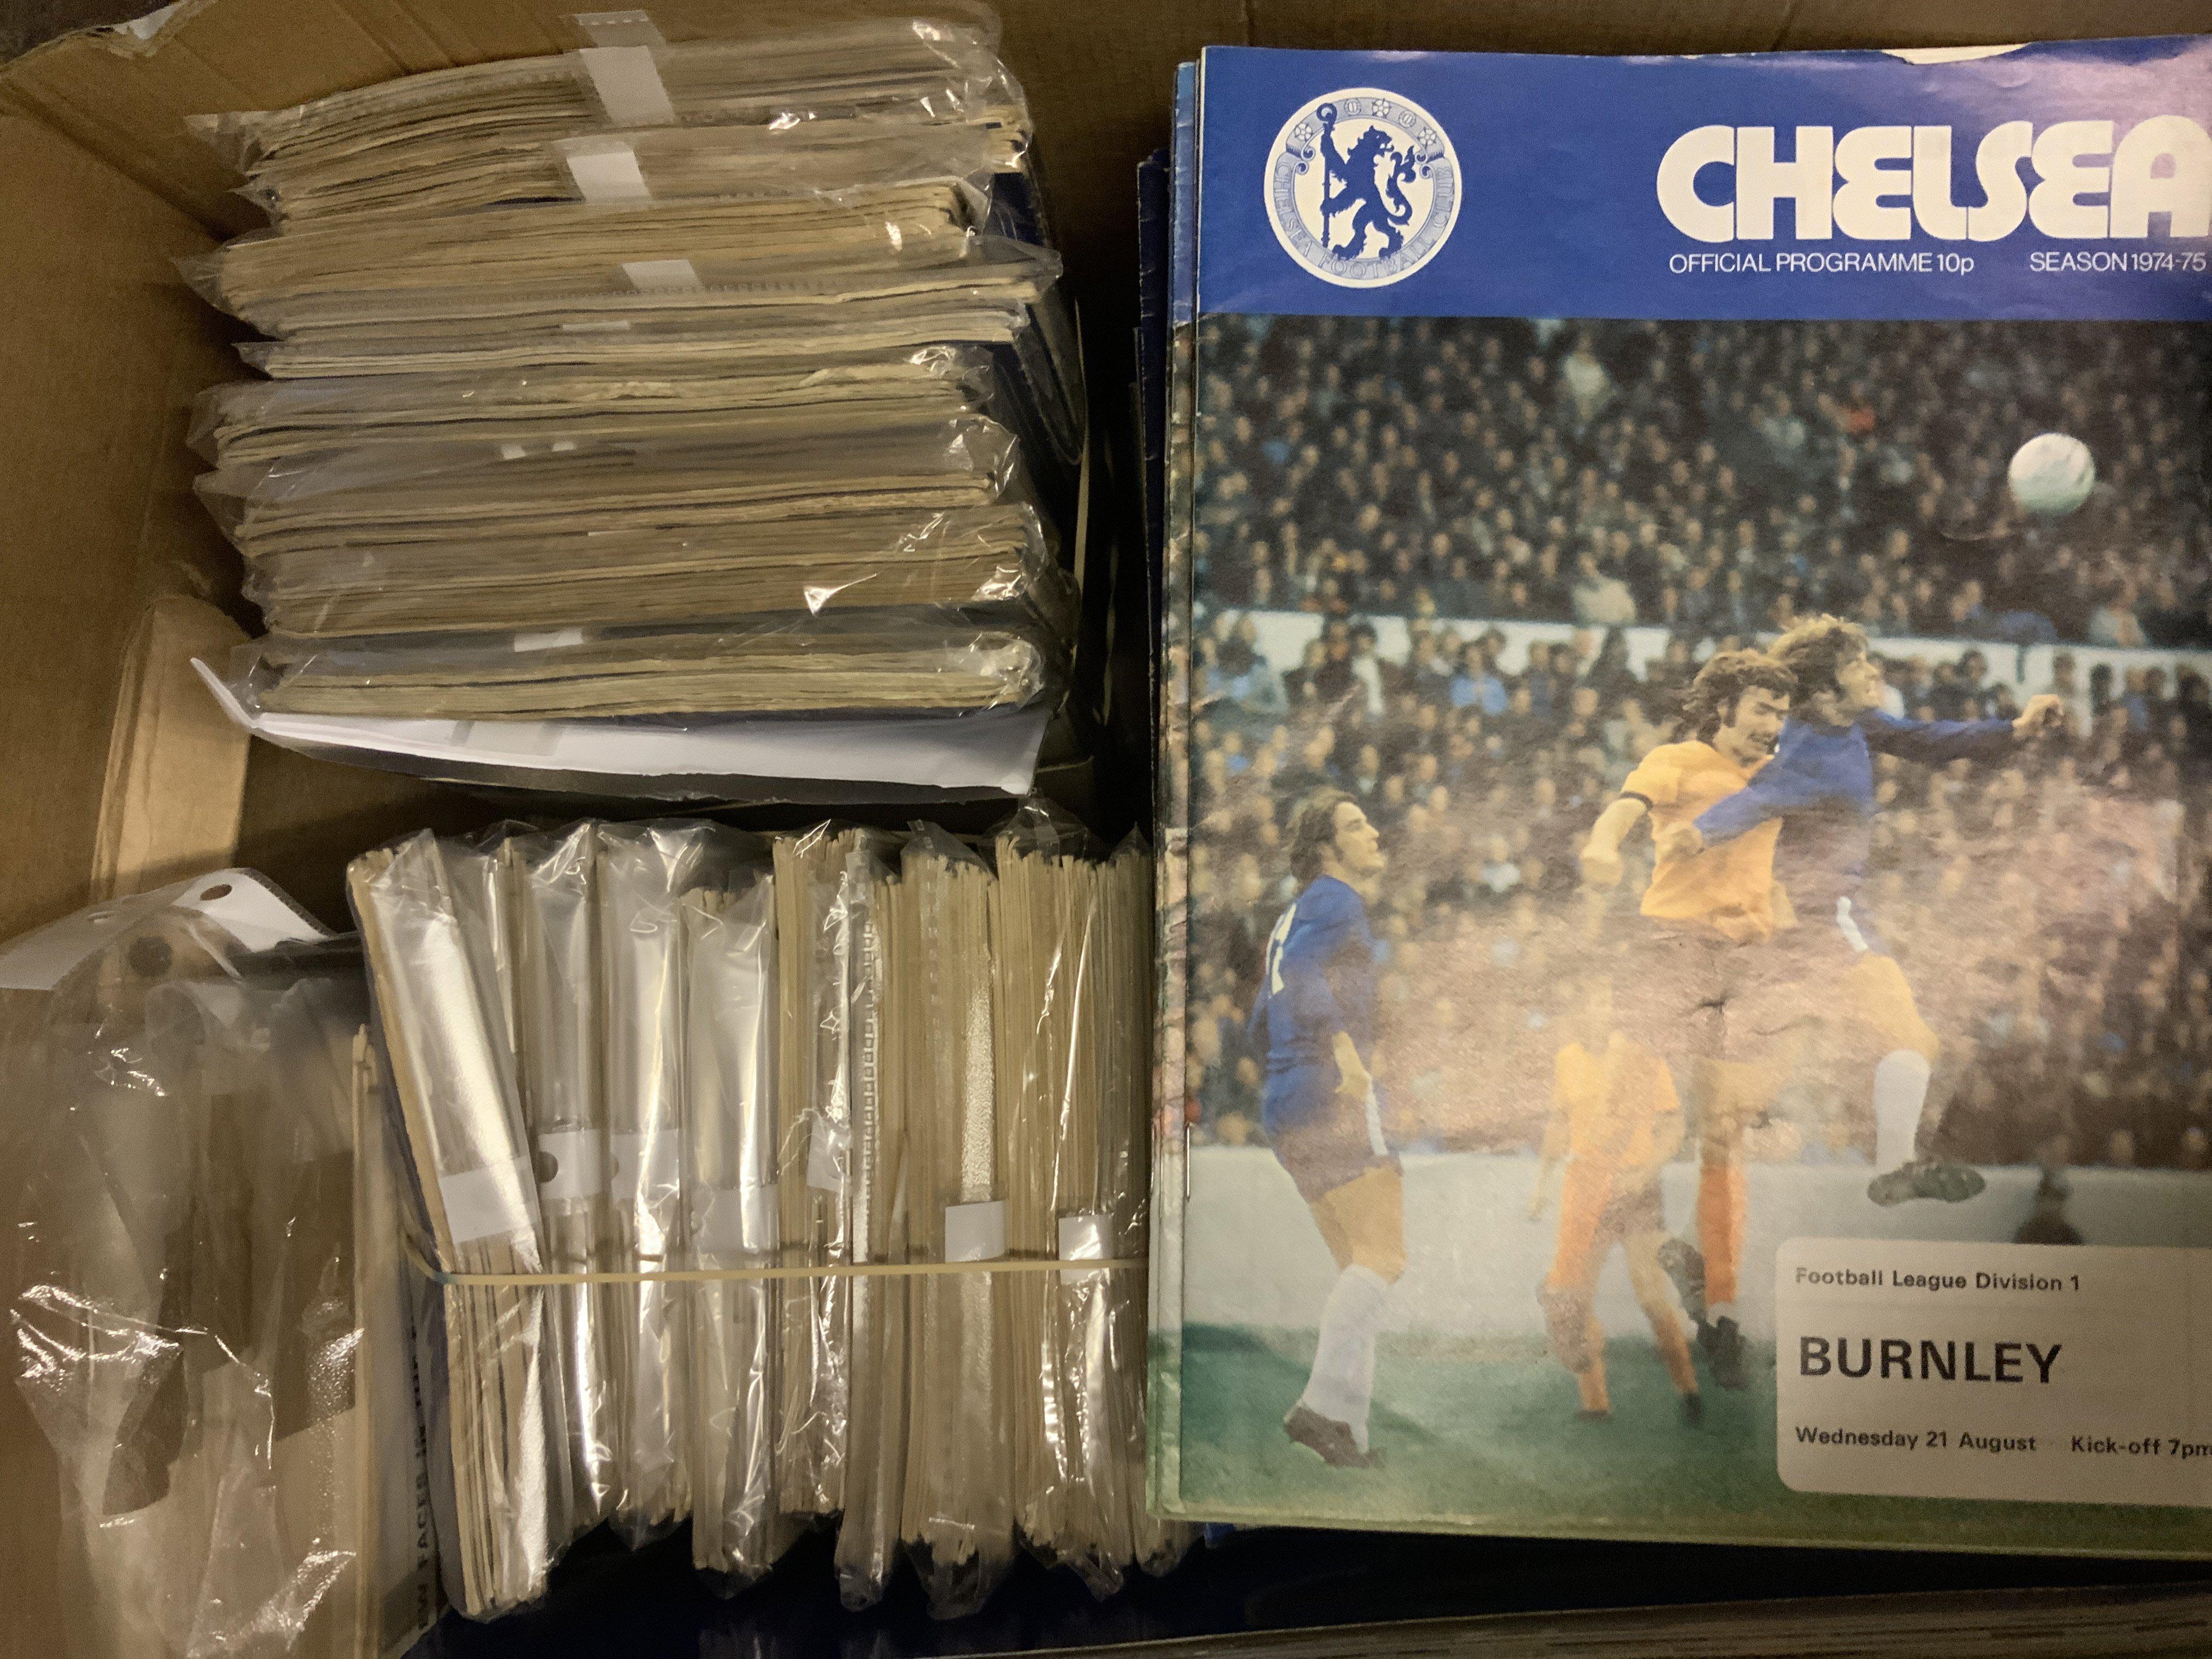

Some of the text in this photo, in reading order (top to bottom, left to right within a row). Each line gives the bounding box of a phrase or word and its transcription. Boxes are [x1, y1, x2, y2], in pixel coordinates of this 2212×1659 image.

[1656, 115, 2212, 242] CHELSEA
[1273, 163, 1454, 279] CHELSEA FOOTBALL CLUB
[1669, 252, 1974, 275] OFFICIAL PROGRAMME 10p
[2030, 252, 2206, 272] SEASON 1974-75
[1795, 1267, 2079, 1291] Football League Division 1
[1799, 1336, 2062, 1384] BURNLEY
[1796, 1426, 2036, 1453] Wednesday 21 August
[2072, 1436, 2160, 1455] Kick-off
